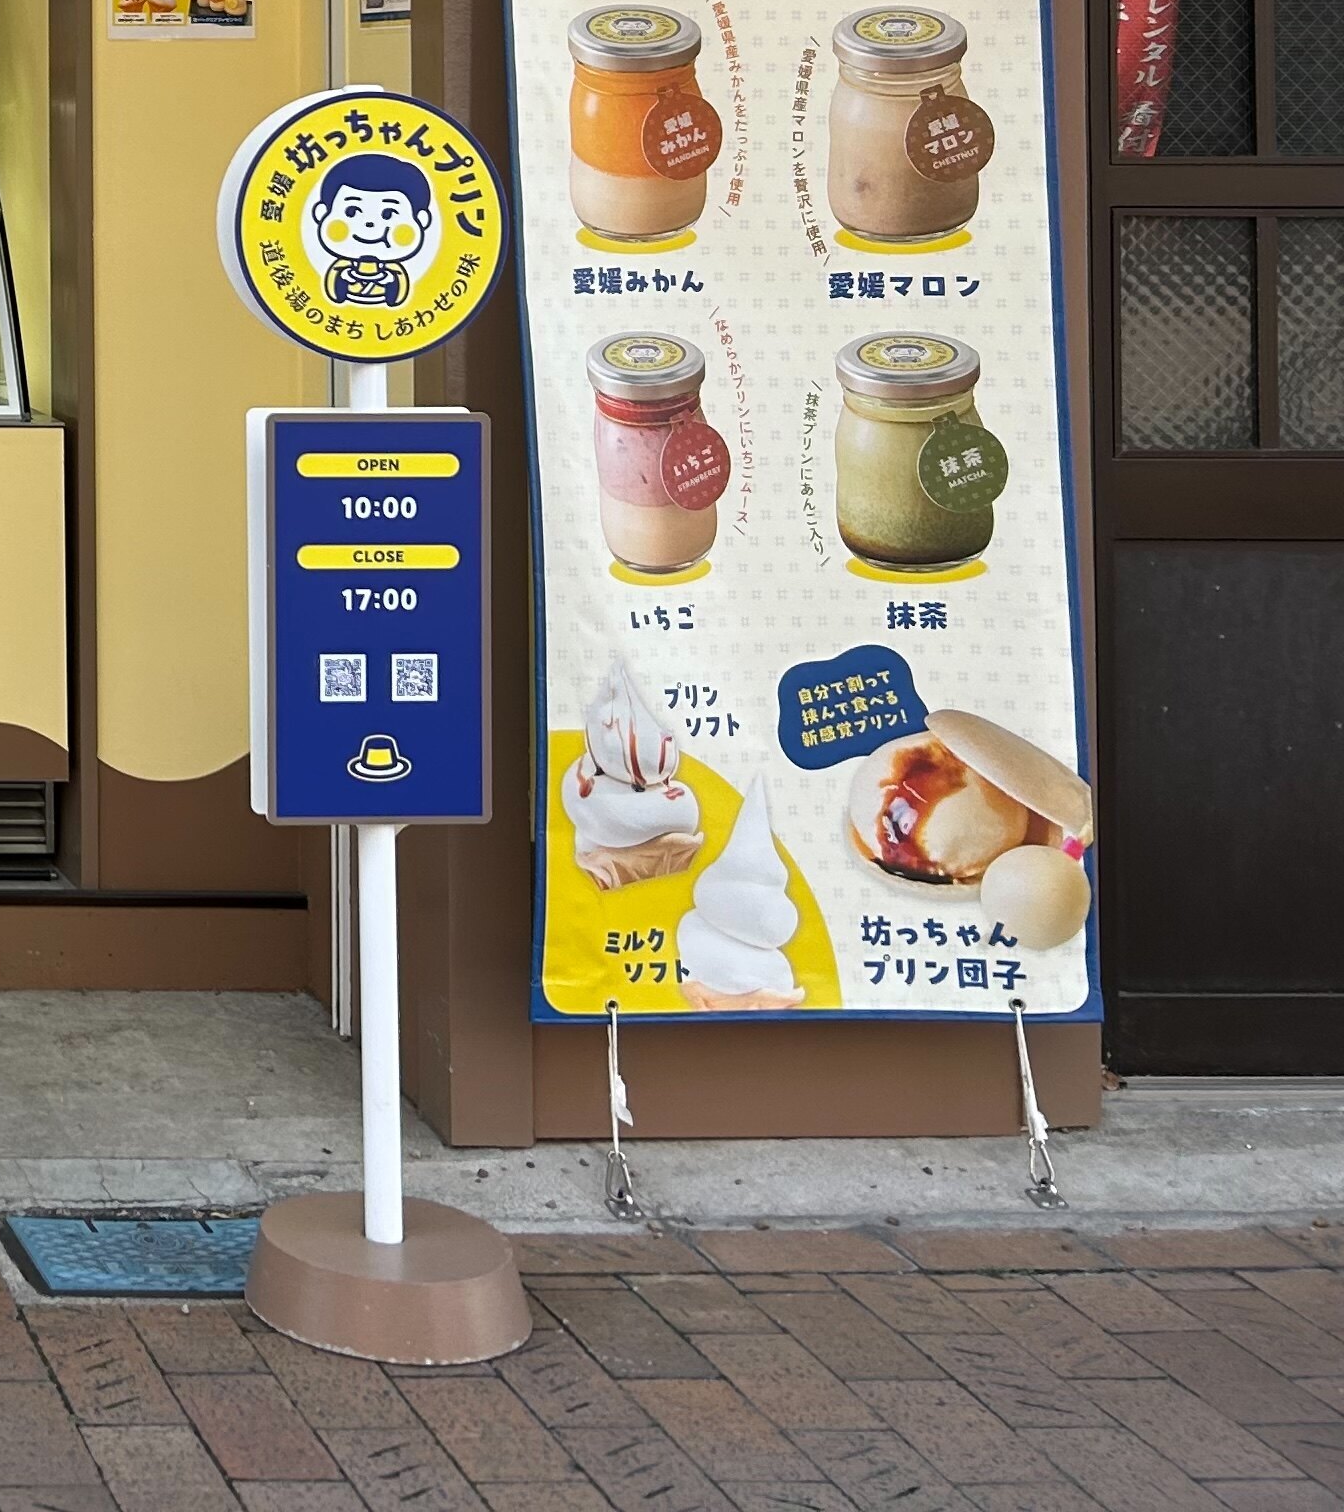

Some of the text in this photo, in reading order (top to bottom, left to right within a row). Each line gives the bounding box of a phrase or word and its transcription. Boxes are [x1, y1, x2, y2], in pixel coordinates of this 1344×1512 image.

[712, 1, 748, 206] 愛媛県産みかんをたっぷり使用
[663, 111, 693, 135] 愛媛
[928, 113, 960, 137] 愛媛
[660, 127, 707, 155] みかん
[791, 48, 828, 257] 愛媛県産マロンを贅沢に使用
[924, 129, 975, 155] マロン
[667, 145, 709, 168] MANDARIN
[932, 146, 979, 169] CHESTNUT
[260, 109, 485, 237] 愛媛 坊っちゃんプリン
[259, 240, 481, 341] 道後湯のまち しあわせの味
[573, 267, 704, 294] 愛媛みかん
[828, 271, 980, 300] 愛媛マロン
[715, 319, 753, 524] なめらかプリンにいちごムース
[357, 459, 399, 471] OPEN
[673, 444, 714, 477] いちご
[800, 392, 824, 555] 抹茶プリンにあんこ入り
[939, 447, 983, 477] 抹茶
[677, 465, 721, 492] STRAWBERRY
[948, 469, 987, 489] MATCHA
[342, 496, 417, 519] 10:00
[353, 550, 404, 563] CLOSE
[342, 588, 417, 611] 17:00
[630, 603, 695, 630] いちご
[886, 601, 947, 630] 抹茶
[664, 681, 718, 709] プリン
[797, 670, 891, 704] 自分で割って
[801, 691, 899, 726] 挟んで食べる
[685, 713, 740, 737] ソフト
[801, 710, 908, 747] 新感覚プリン!
[605, 928, 664, 954] ミルク
[860, 915, 1018, 948] 坊っちゃん
[624, 961, 690, 983] ソフト
[863, 954, 1026, 991] プリン団子
